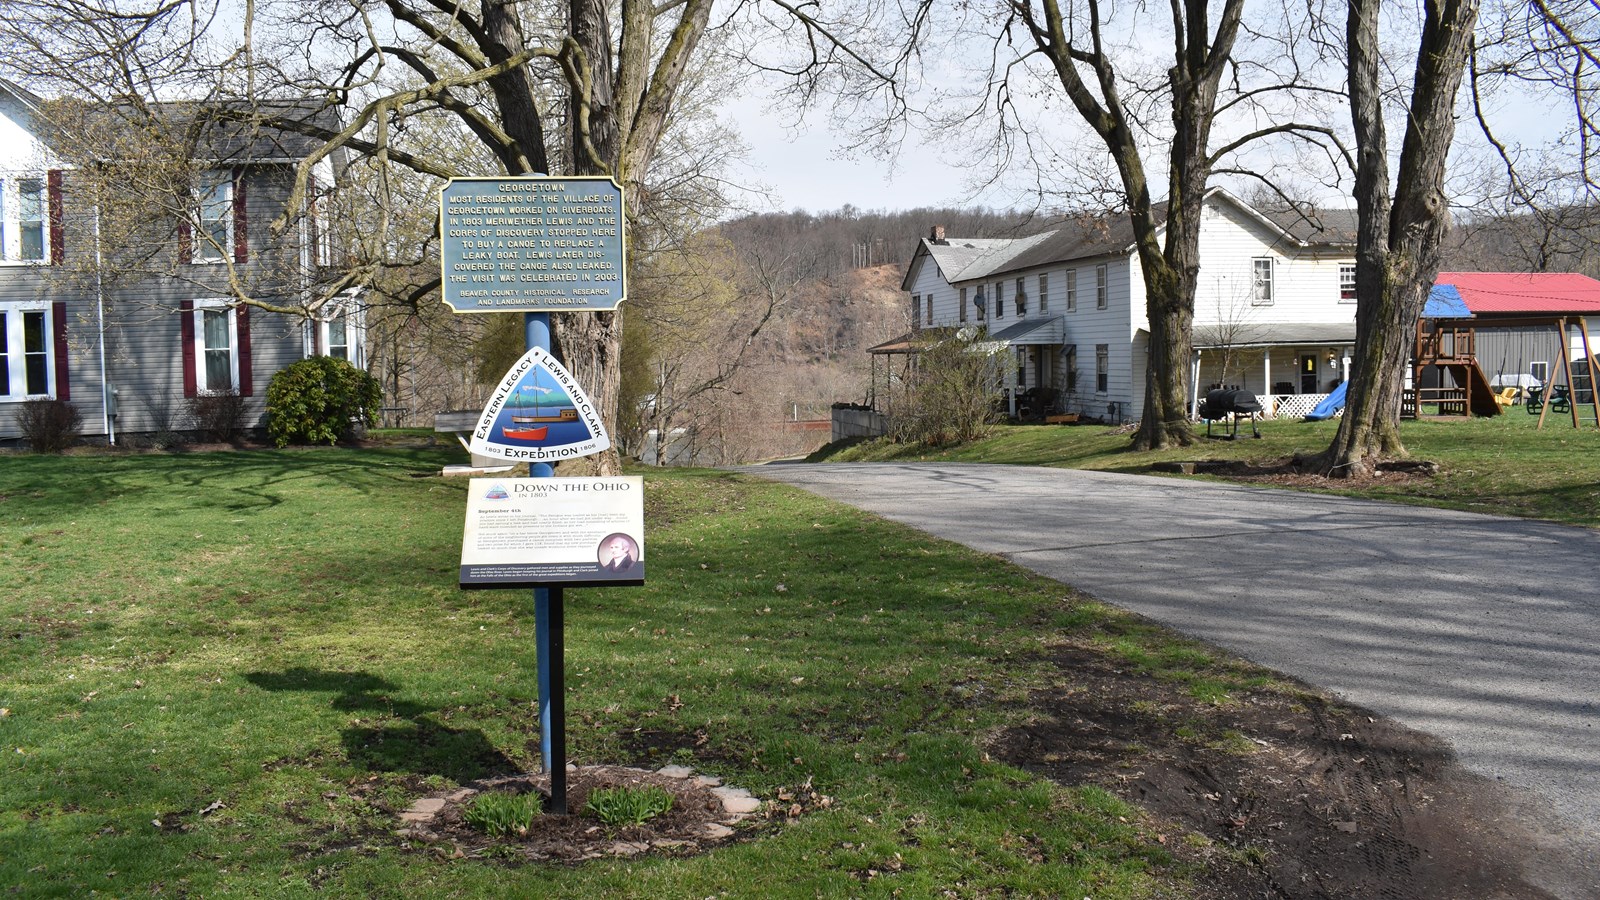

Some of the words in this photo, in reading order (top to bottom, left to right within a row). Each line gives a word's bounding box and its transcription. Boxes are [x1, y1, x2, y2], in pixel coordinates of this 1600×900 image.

[476, 393, 504, 440] EASTERN
[501, 357, 532, 393] LEGACY
[541, 355, 569, 385] LEWIS
[567, 385, 583, 404] AND
[581, 404, 603, 438] CLARK
[505, 447, 578, 459] EXPEDITION
[514, 483, 558, 492] DOWN
[563, 483, 588, 492] THE
[592, 482, 630, 491] OHIO
